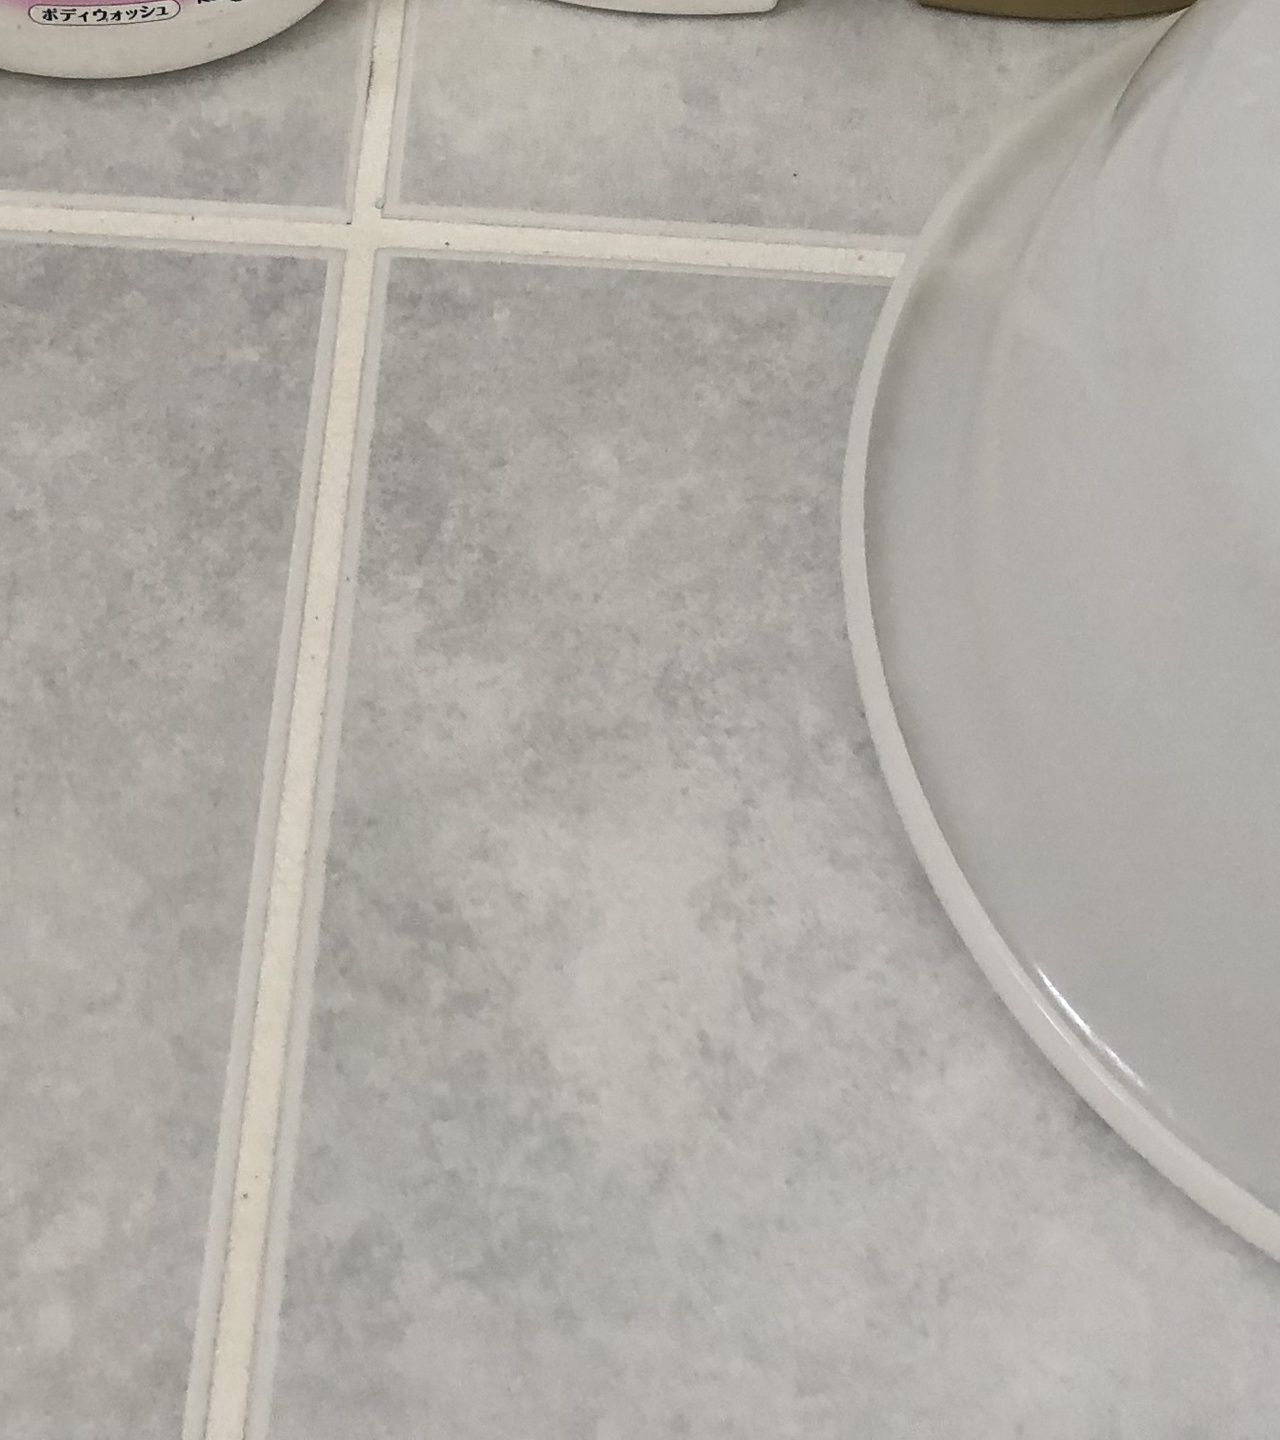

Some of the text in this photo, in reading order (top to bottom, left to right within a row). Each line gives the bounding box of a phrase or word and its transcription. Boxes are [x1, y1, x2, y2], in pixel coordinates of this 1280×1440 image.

[41, 5, 170, 23] ボディウォッシュ
